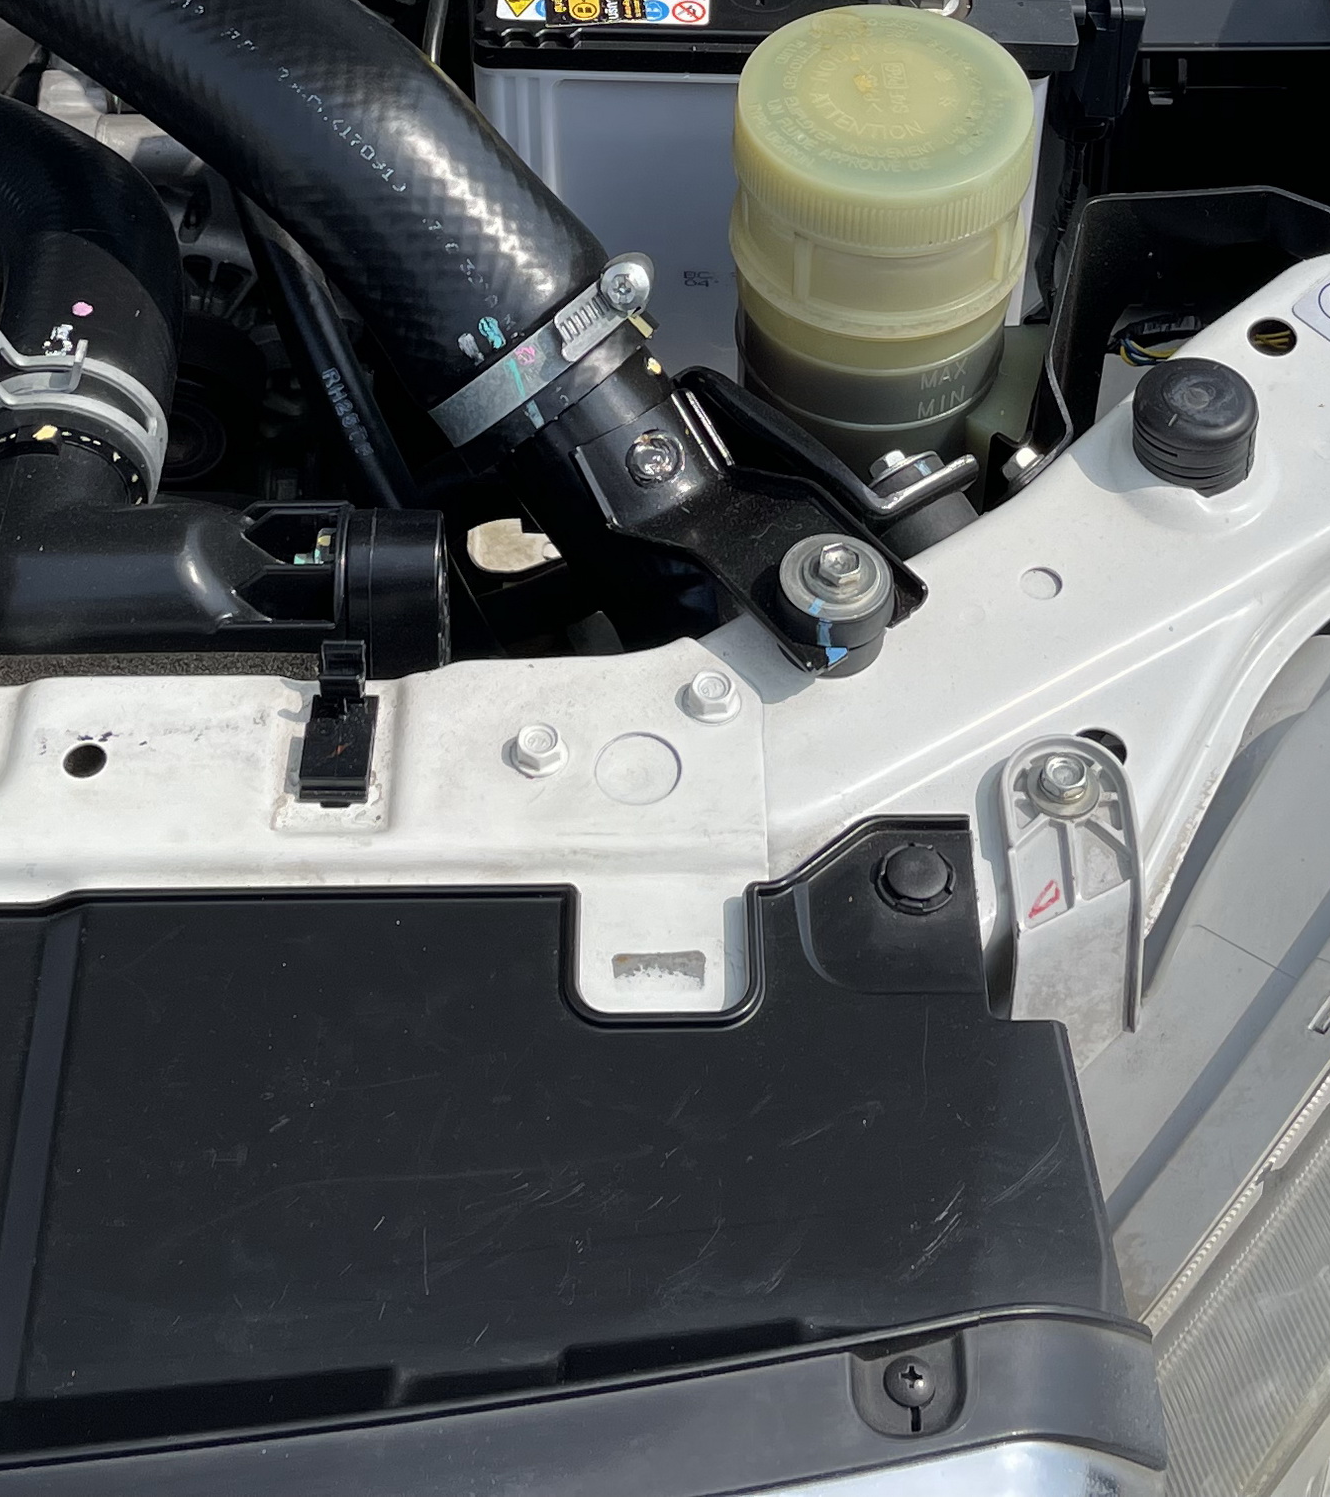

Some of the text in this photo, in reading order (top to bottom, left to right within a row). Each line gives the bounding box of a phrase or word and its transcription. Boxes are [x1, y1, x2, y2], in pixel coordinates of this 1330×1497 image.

[809, 92, 928, 141] ATTENTION
[920, 357, 968, 391] MAX
[917, 385, 966, 420] MIN
